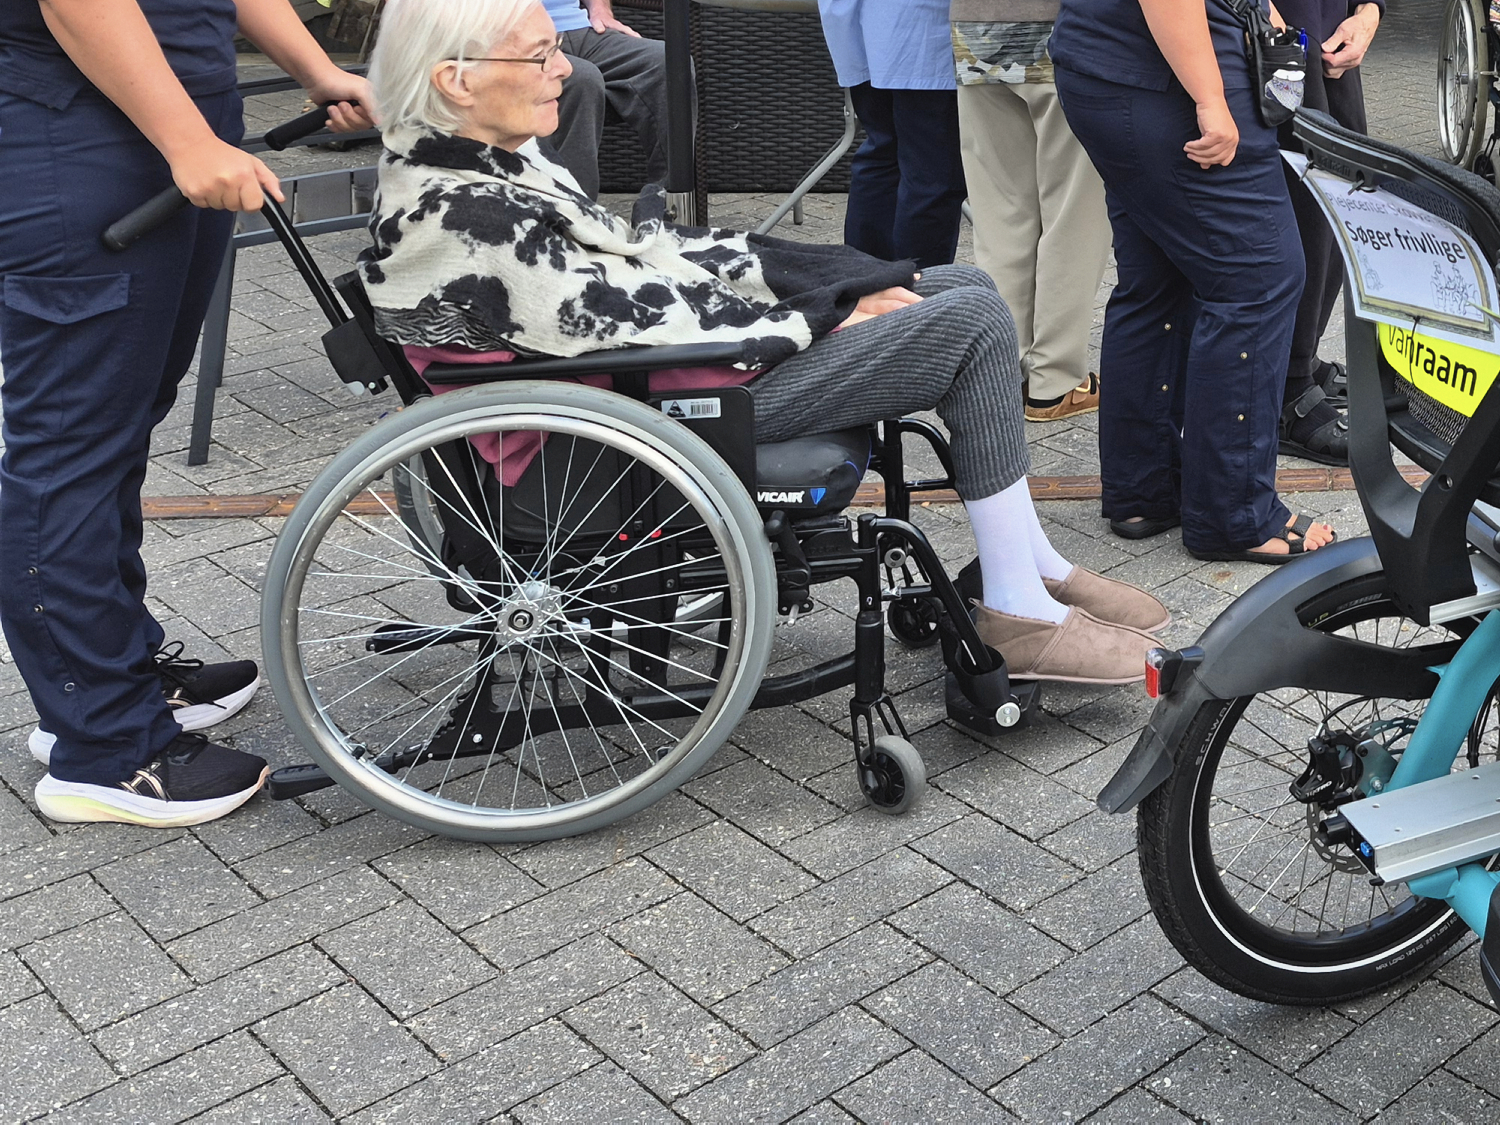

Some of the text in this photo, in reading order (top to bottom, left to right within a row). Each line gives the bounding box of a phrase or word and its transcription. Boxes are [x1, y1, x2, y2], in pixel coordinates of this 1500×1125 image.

[1344, 220, 1466, 264] Søger frivllige
[1389, 324, 1478, 397] vanraam
[757, 490, 805, 503] VICAIR
